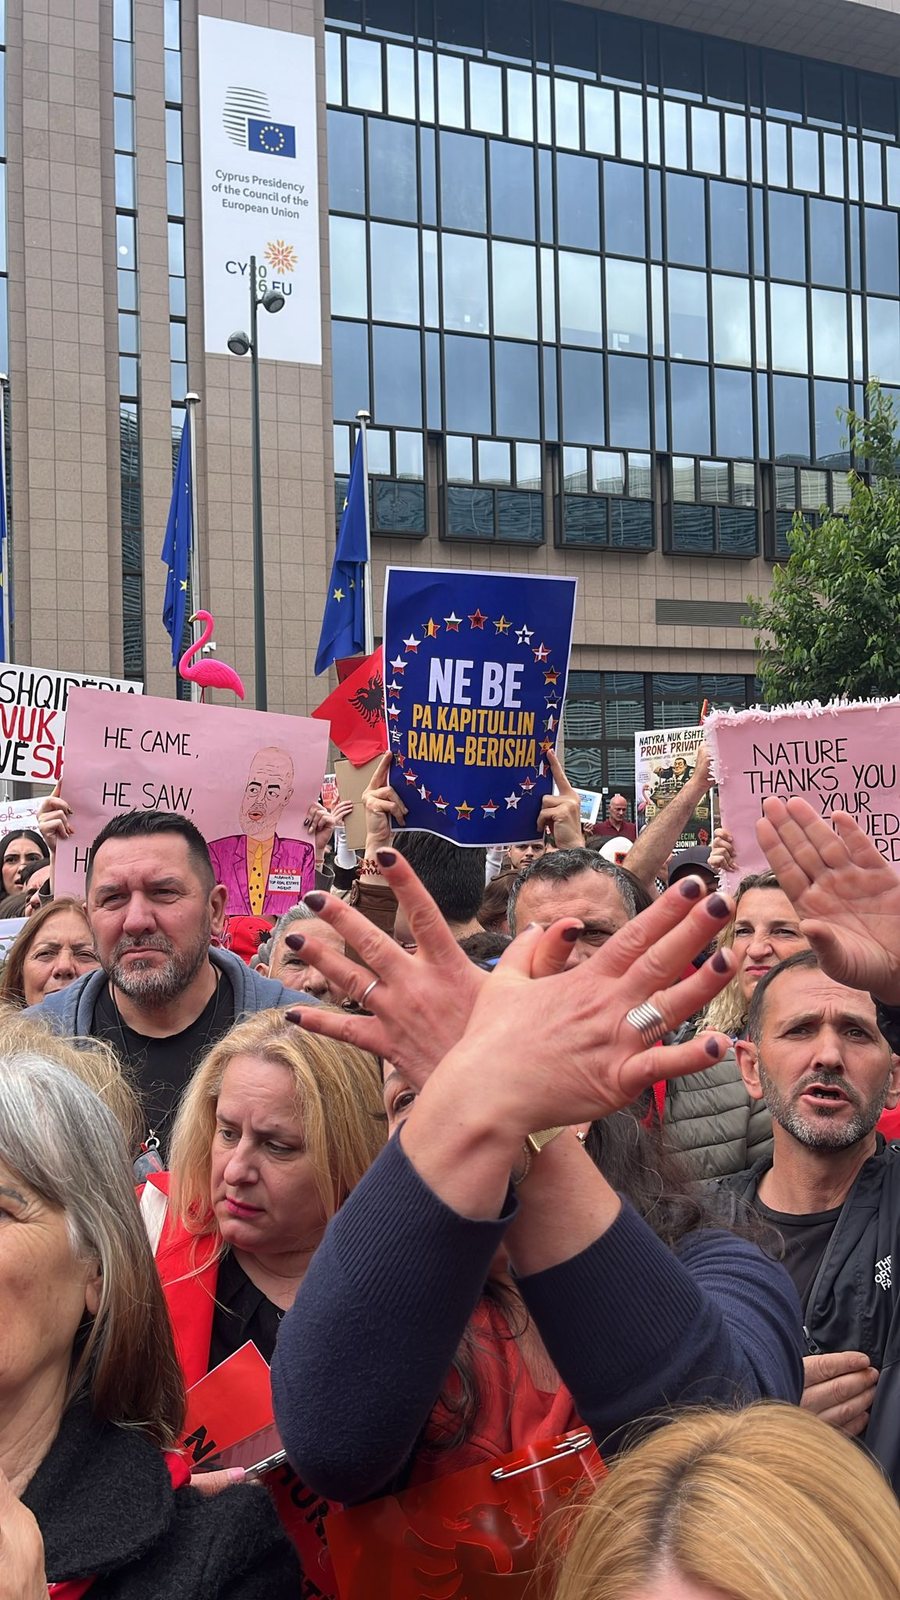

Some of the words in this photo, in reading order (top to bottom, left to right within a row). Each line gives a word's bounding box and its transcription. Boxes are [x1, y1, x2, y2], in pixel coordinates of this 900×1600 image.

[215, 169, 250, 183] Cyprus
[252, 175, 305, 194] Presidency
[212, 183, 222, 193] of
[224, 185, 241, 196] the
[242, 188, 279, 202] Council
[280, 192, 291, 203] of
[292, 194, 309, 207] the
[222, 198, 270, 216] European
[271, 206, 300, 220] Union
[226, 261, 248, 276] CY
[428, 658, 474, 706] NE
[481, 662, 524, 708] BE
[412, 704, 432, 729] PA
[437, 706, 535, 736] KAPITULLIN
[104, 726, 132, 750] HE
[140, 730, 199, 758] CAME,
[408, 730, 536, 767] RAMA-BERISHA
[640, 734, 664, 746] NATYRA
[667, 733, 682, 742] NUK
[753, 738, 848, 766] NATURE
[744, 765, 839, 794] THANKS
[852, 764, 896, 789] YOU
[102, 782, 131, 808] HE
[142, 783, 195, 814] SAW,
[820, 792, 872, 814] YOUR
[74, 847, 89, 872] H
[875, 1266, 891, 1283] ORT
